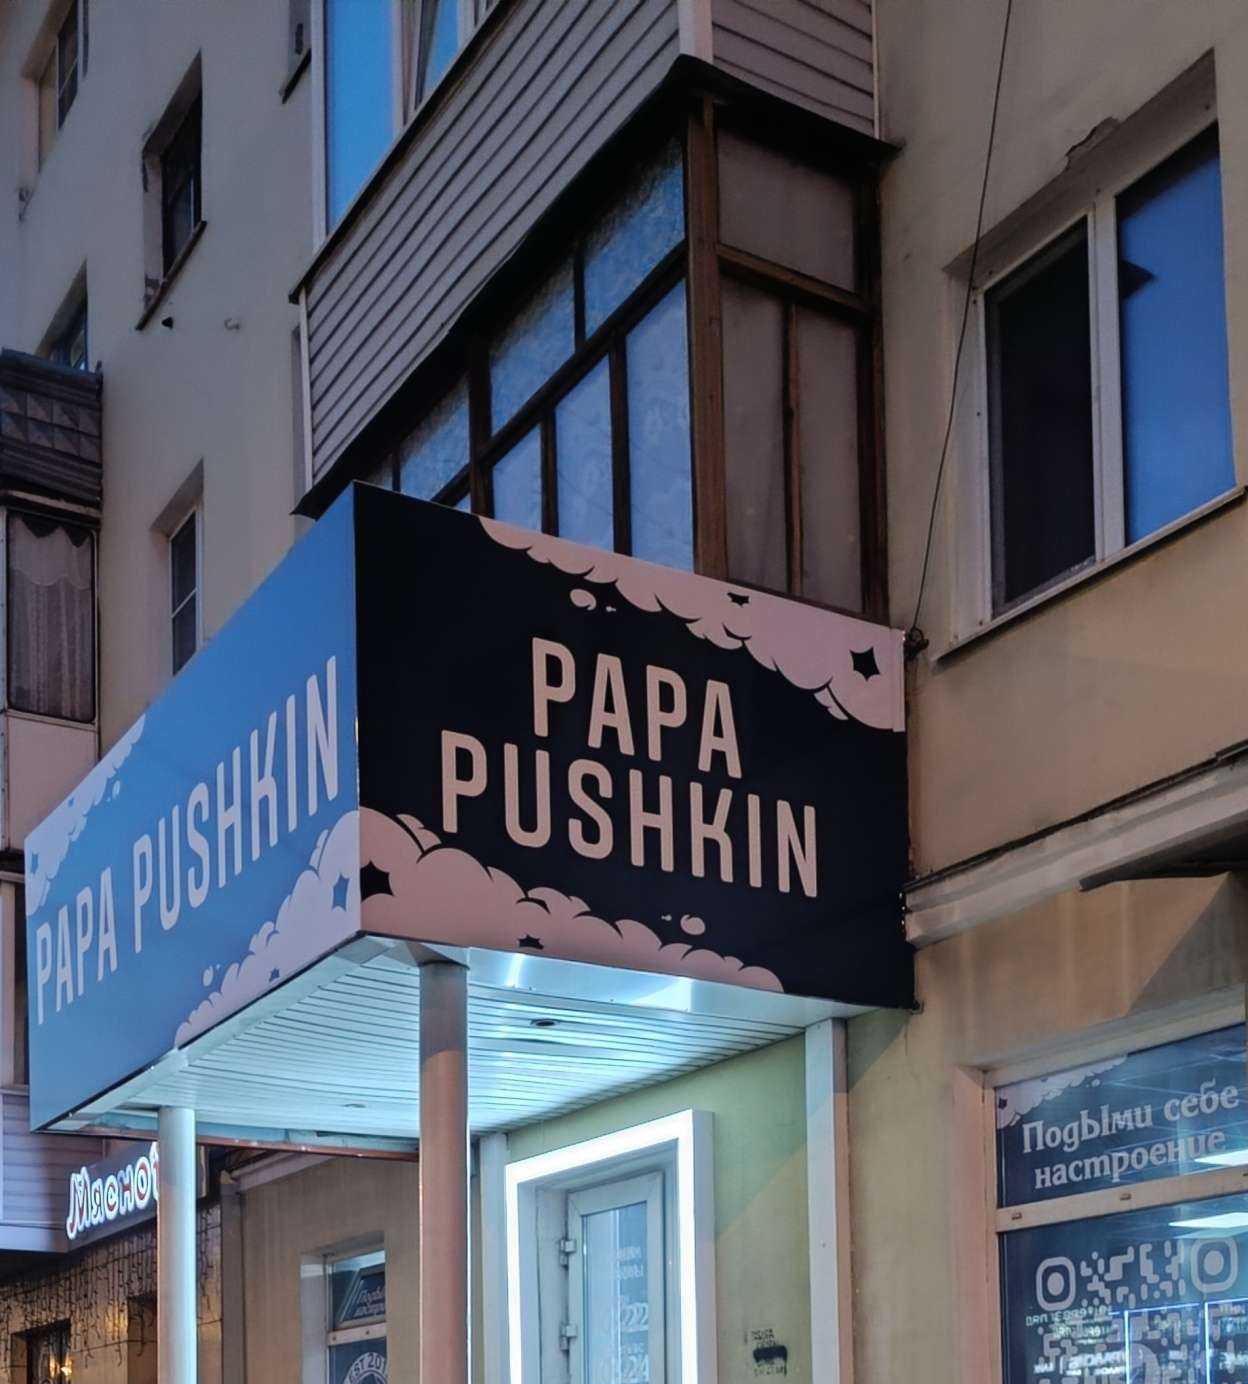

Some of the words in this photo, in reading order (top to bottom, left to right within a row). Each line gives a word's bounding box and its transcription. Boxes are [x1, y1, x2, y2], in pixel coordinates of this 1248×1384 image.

[532, 637, 743, 778] PAPA
[35, 866, 118, 1026] PAPA
[133, 655, 339, 953] PUSHKIN
[441, 729, 819, 898] PUSHKIN
[1034, 1131, 1226, 1189] настроение
[1163, 1078, 1239, 1121] себе
